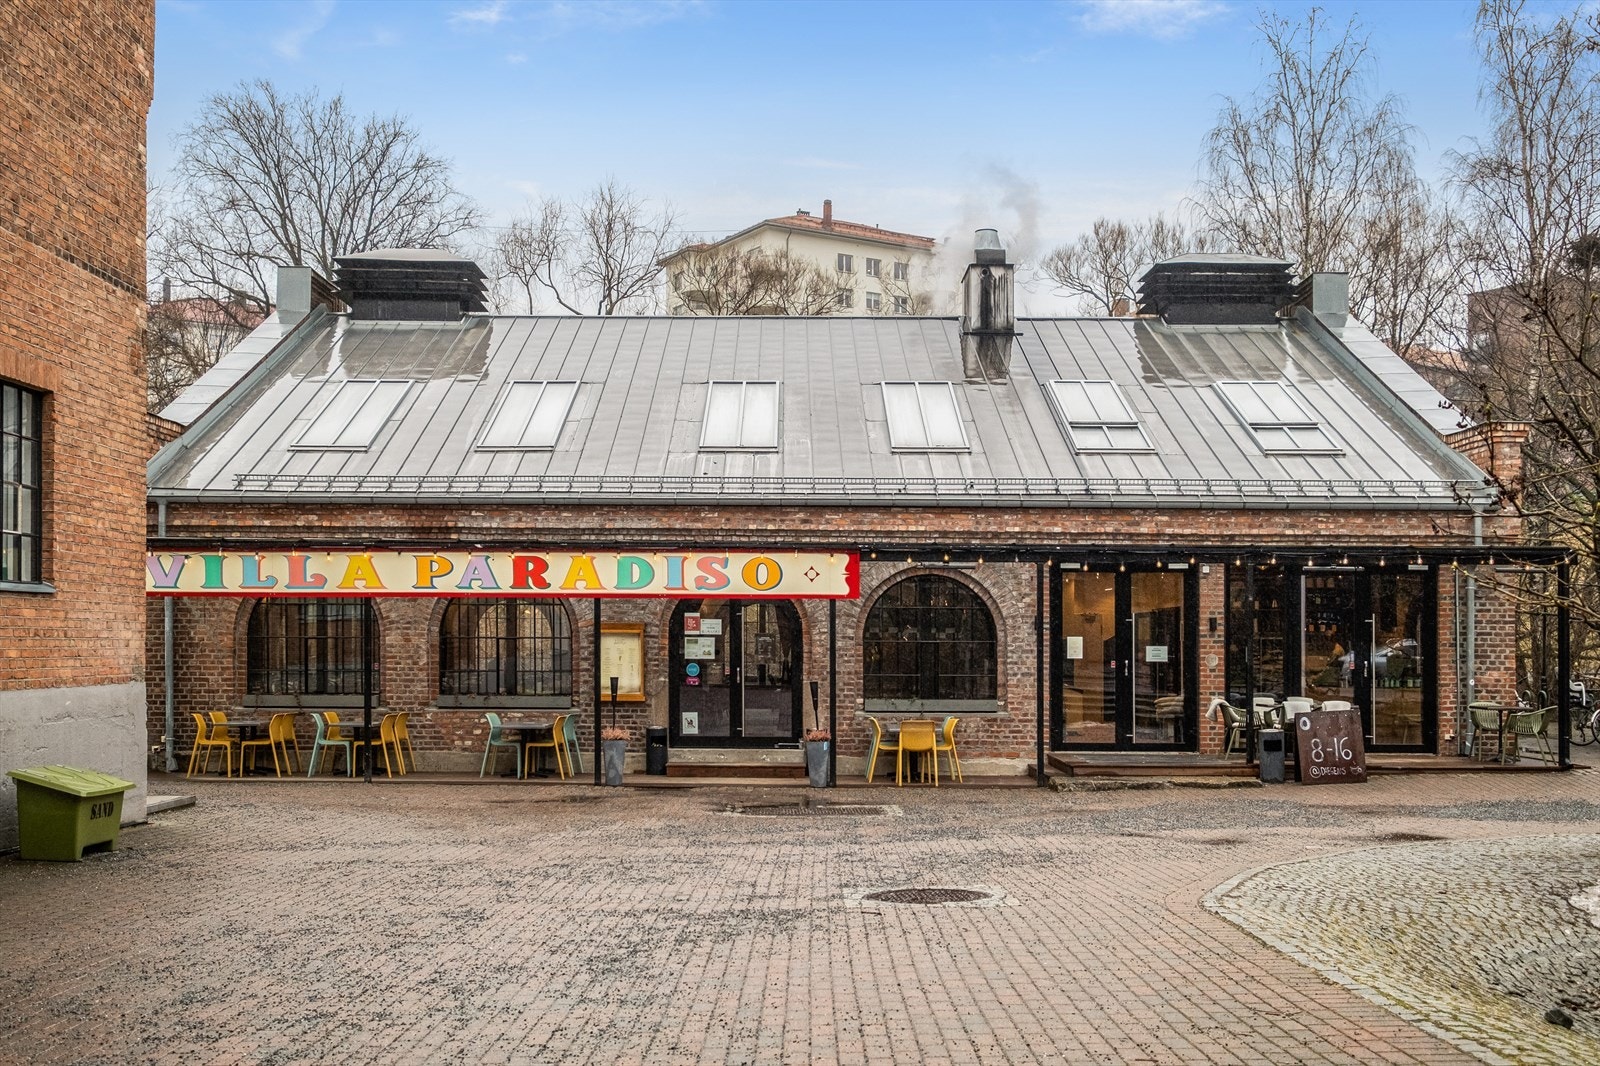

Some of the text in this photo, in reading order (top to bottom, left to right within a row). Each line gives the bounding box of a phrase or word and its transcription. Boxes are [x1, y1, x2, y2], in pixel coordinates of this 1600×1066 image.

[146, 554, 784, 592] VILLA PARADISO
[1311, 737, 1352, 762] 8-16
[90, 801, 114, 820] SAND
